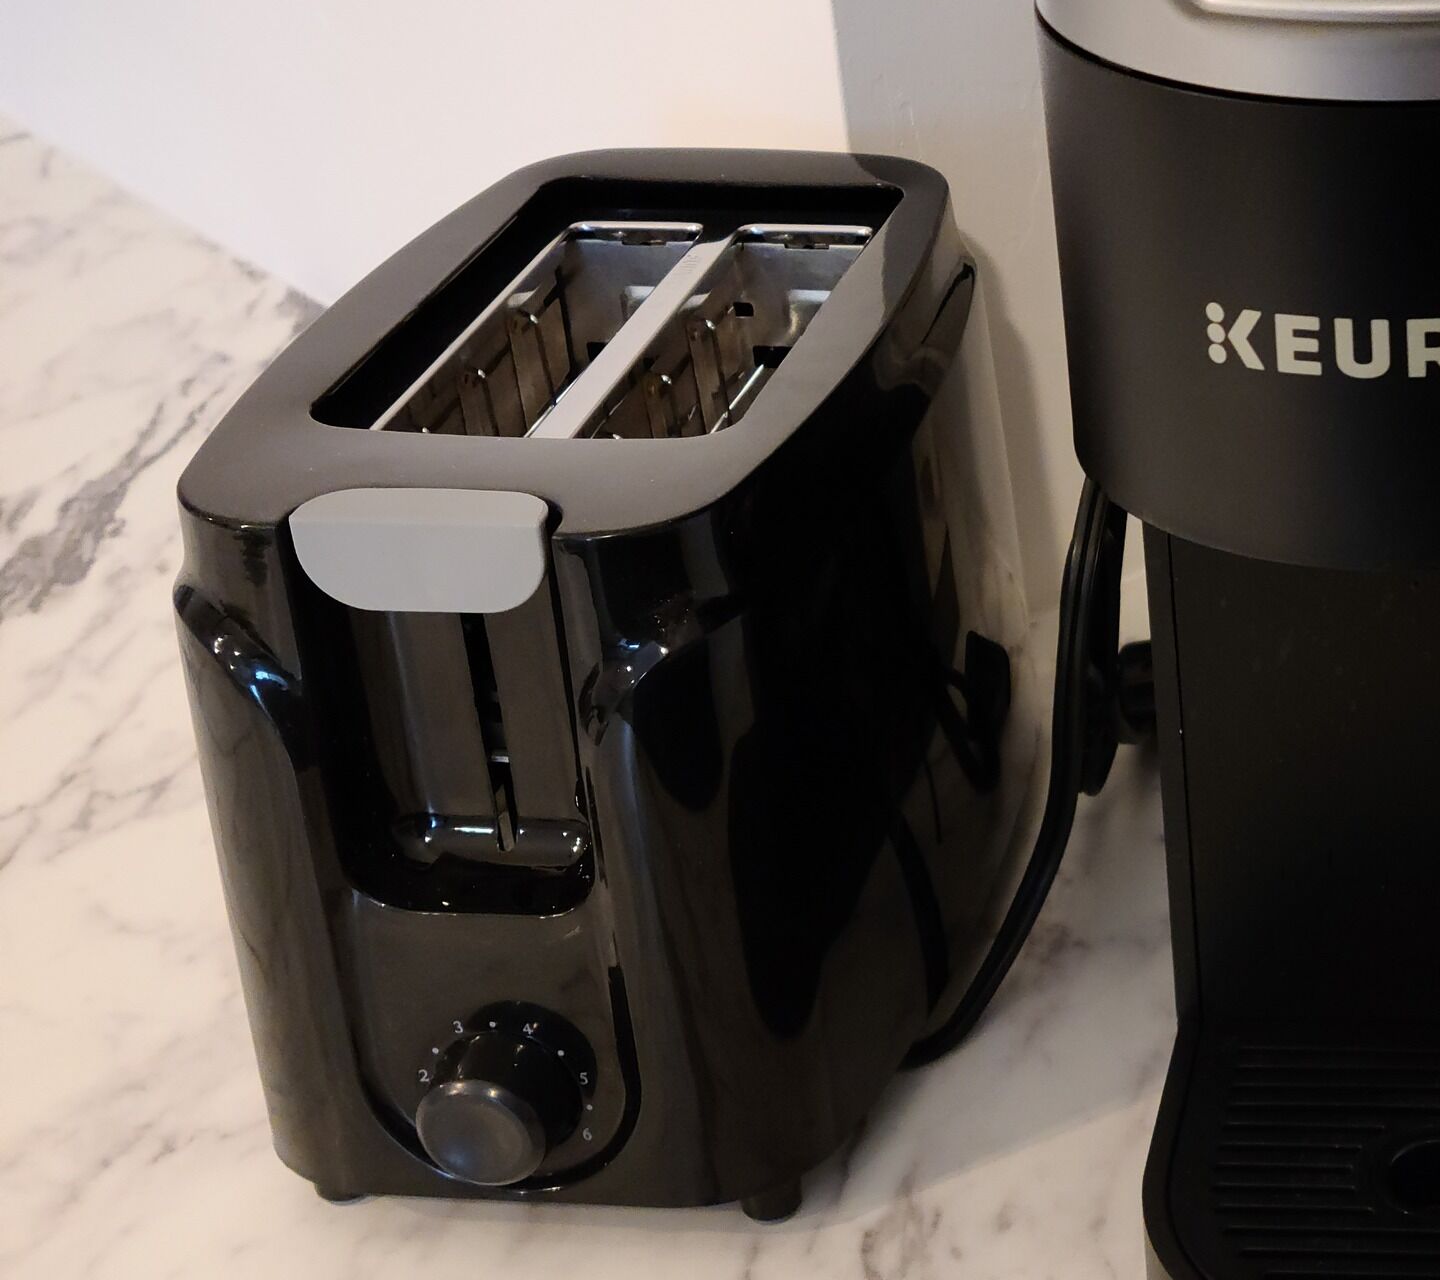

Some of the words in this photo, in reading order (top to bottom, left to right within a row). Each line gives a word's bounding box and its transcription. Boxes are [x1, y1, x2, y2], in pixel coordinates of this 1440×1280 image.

[452, 1020, 464, 1034] 3
[522, 1023, 533, 1035] 4
[418, 1070, 430, 1083] 2
[579, 1071, 589, 1085] 5
[582, 1128, 592, 1141] 6
